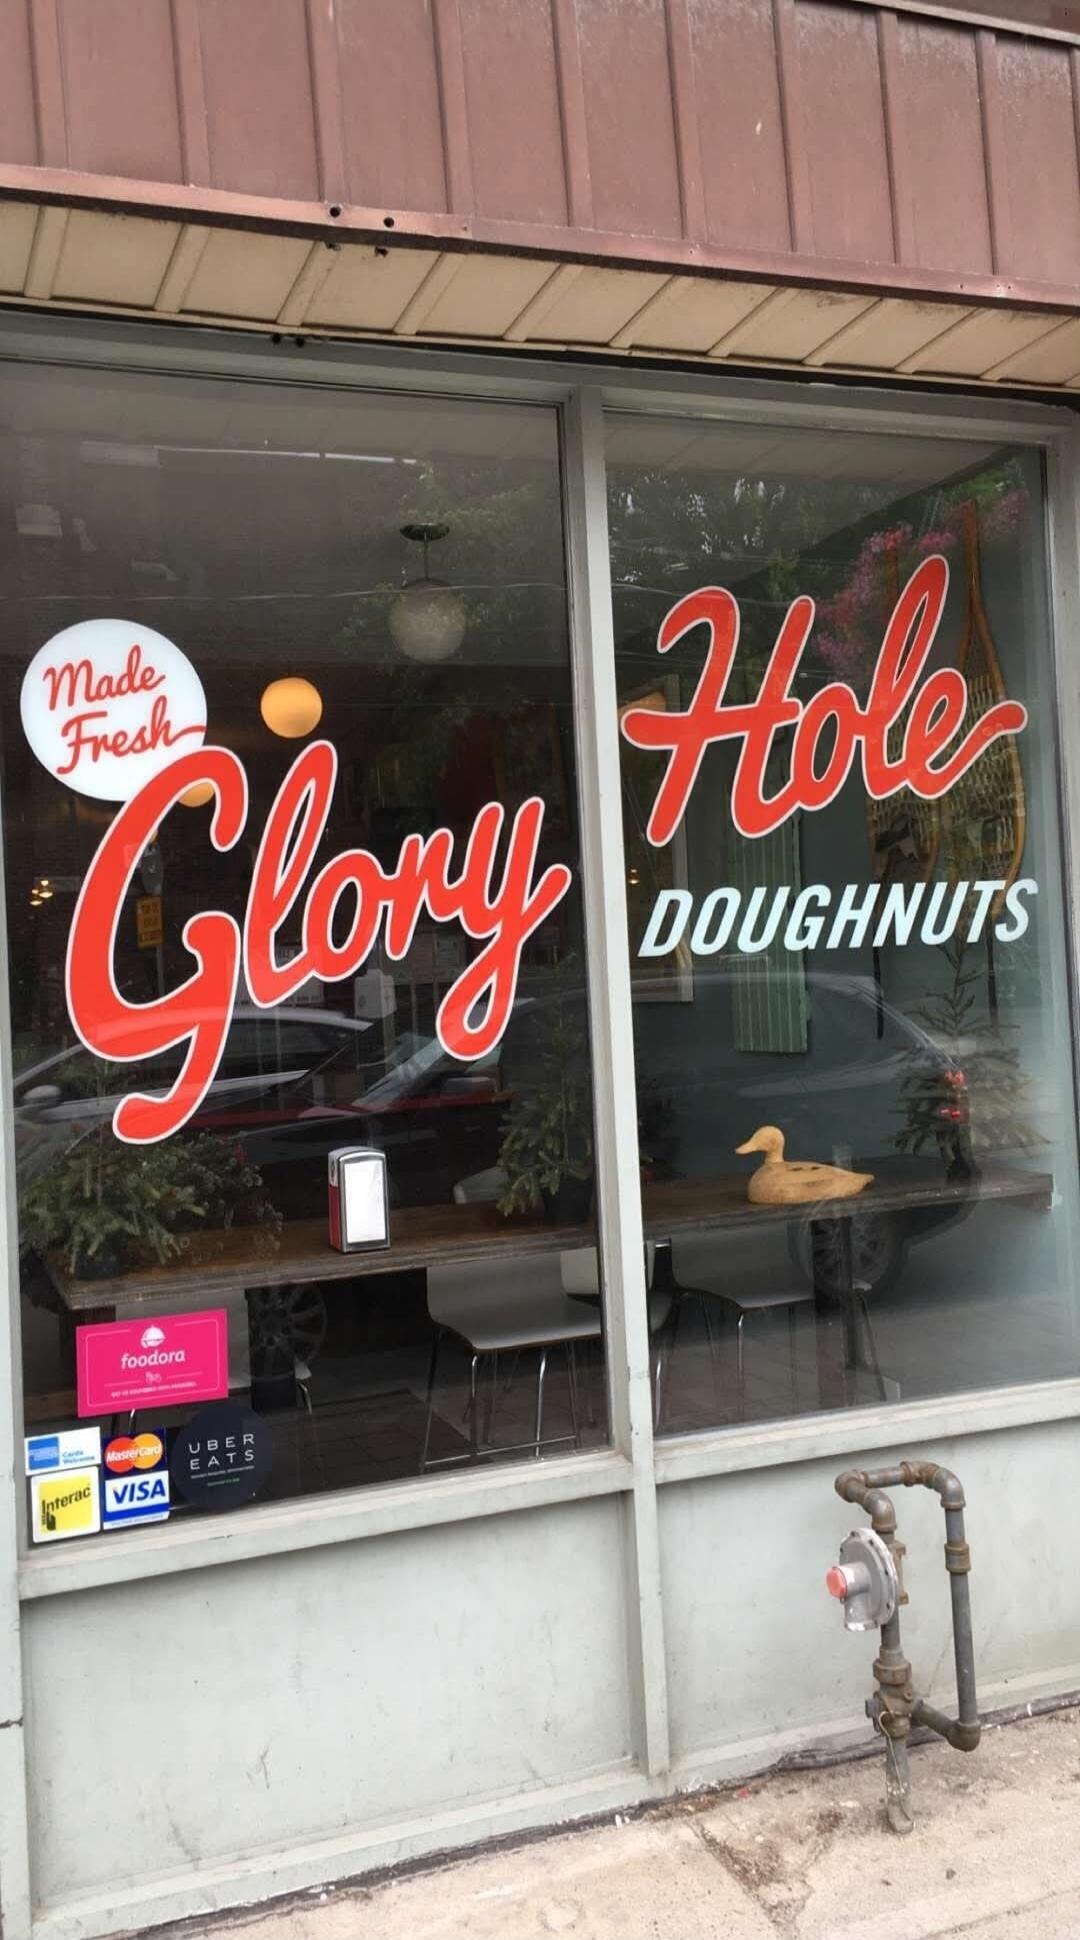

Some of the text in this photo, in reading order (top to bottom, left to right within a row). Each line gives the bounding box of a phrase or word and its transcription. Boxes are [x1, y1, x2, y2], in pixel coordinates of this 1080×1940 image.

[43, 644, 167, 712] Made
[621, 553, 1028, 848] Hole
[57, 695, 207, 775] Fresh
[637, 878, 1039, 958] DOUGHNUTS
[65, 739, 572, 1145] Glory
[120, 1349, 187, 1371] foodora
[105, 1444, 163, 1463] MasterCard
[188, 1433, 255, 1454] UBER
[189, 1450, 255, 1471] EATS
[41, 1485, 91, 1515] Interac
[112, 1479, 167, 1505] VISA
